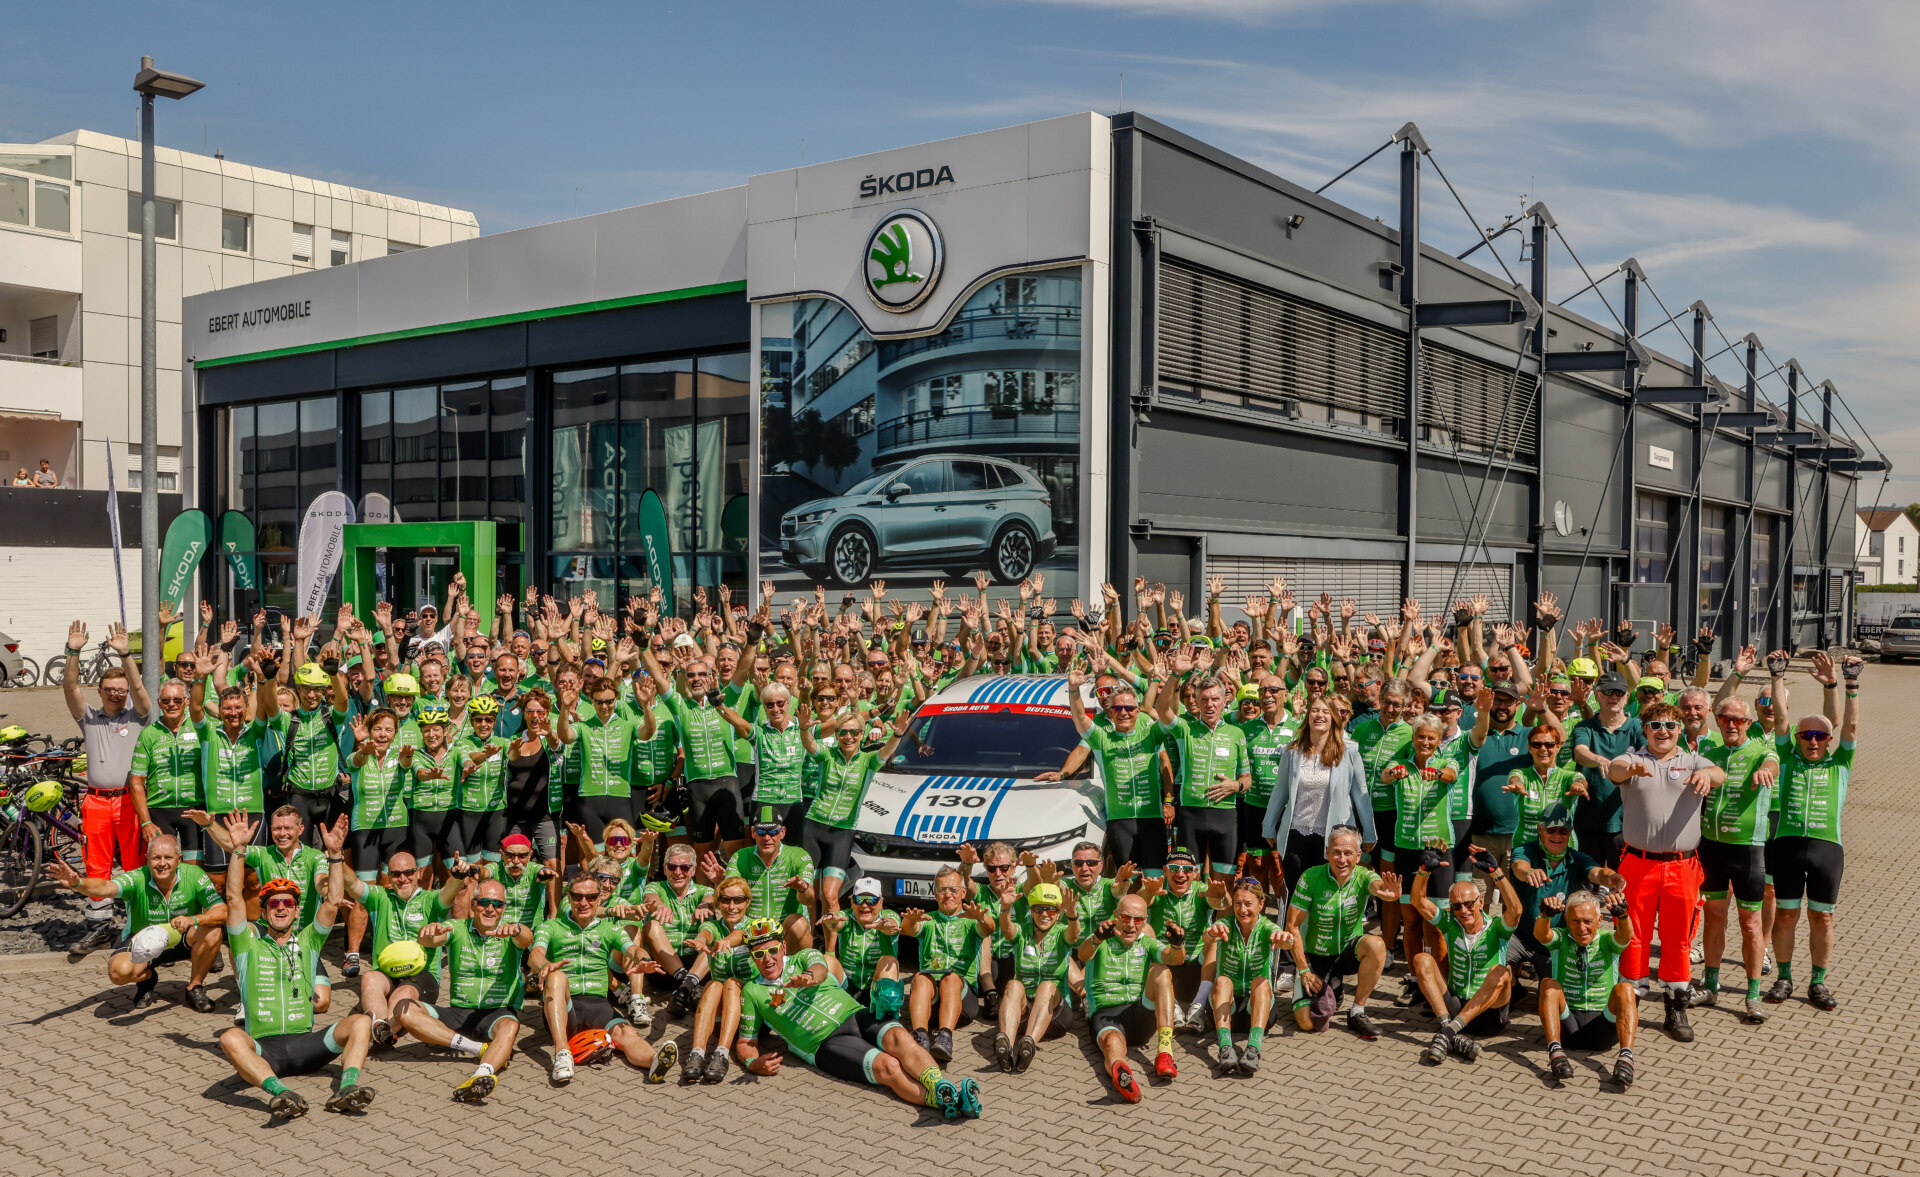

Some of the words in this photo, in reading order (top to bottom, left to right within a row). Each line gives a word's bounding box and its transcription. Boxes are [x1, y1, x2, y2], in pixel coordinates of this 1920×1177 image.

[860, 165, 955, 198] ŠKODA
[209, 313, 239, 333] EBERT
[242, 300, 311, 327] AUTOMOBILE
[307, 583, 320, 612] EBERT
[319, 524, 342, 582] AUTOMOBILE
[926, 794, 987, 808] 130
[904, 881, 919, 894] DA
